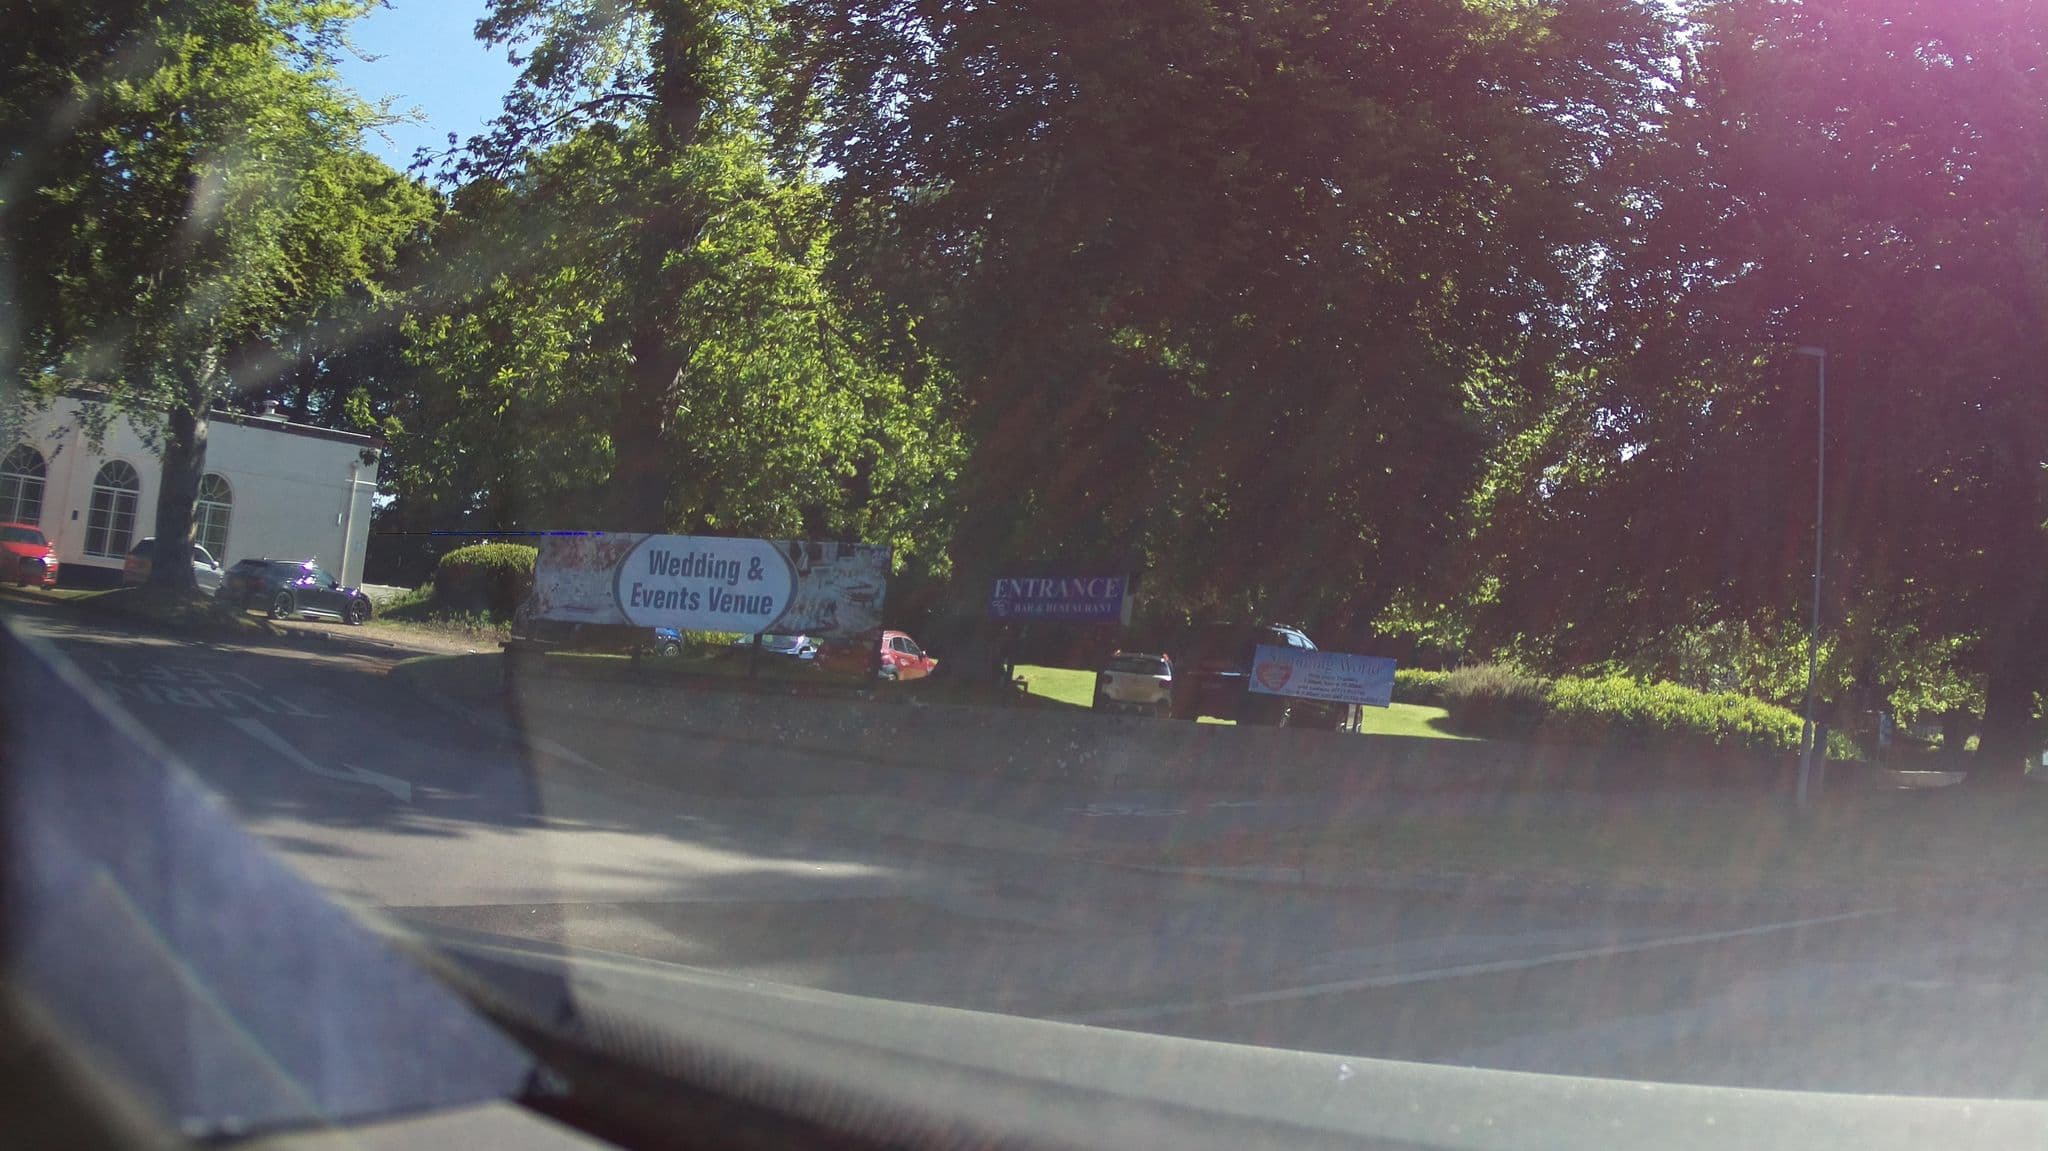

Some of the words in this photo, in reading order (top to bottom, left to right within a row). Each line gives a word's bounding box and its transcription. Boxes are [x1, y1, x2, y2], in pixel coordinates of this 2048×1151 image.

[650, 550, 741, 586] Wedding
[747, 556, 765, 581] &
[630, 582, 700, 612] Events
[708, 586, 773, 615] Venue
[993, 577, 1120, 598] ENTRANCE
